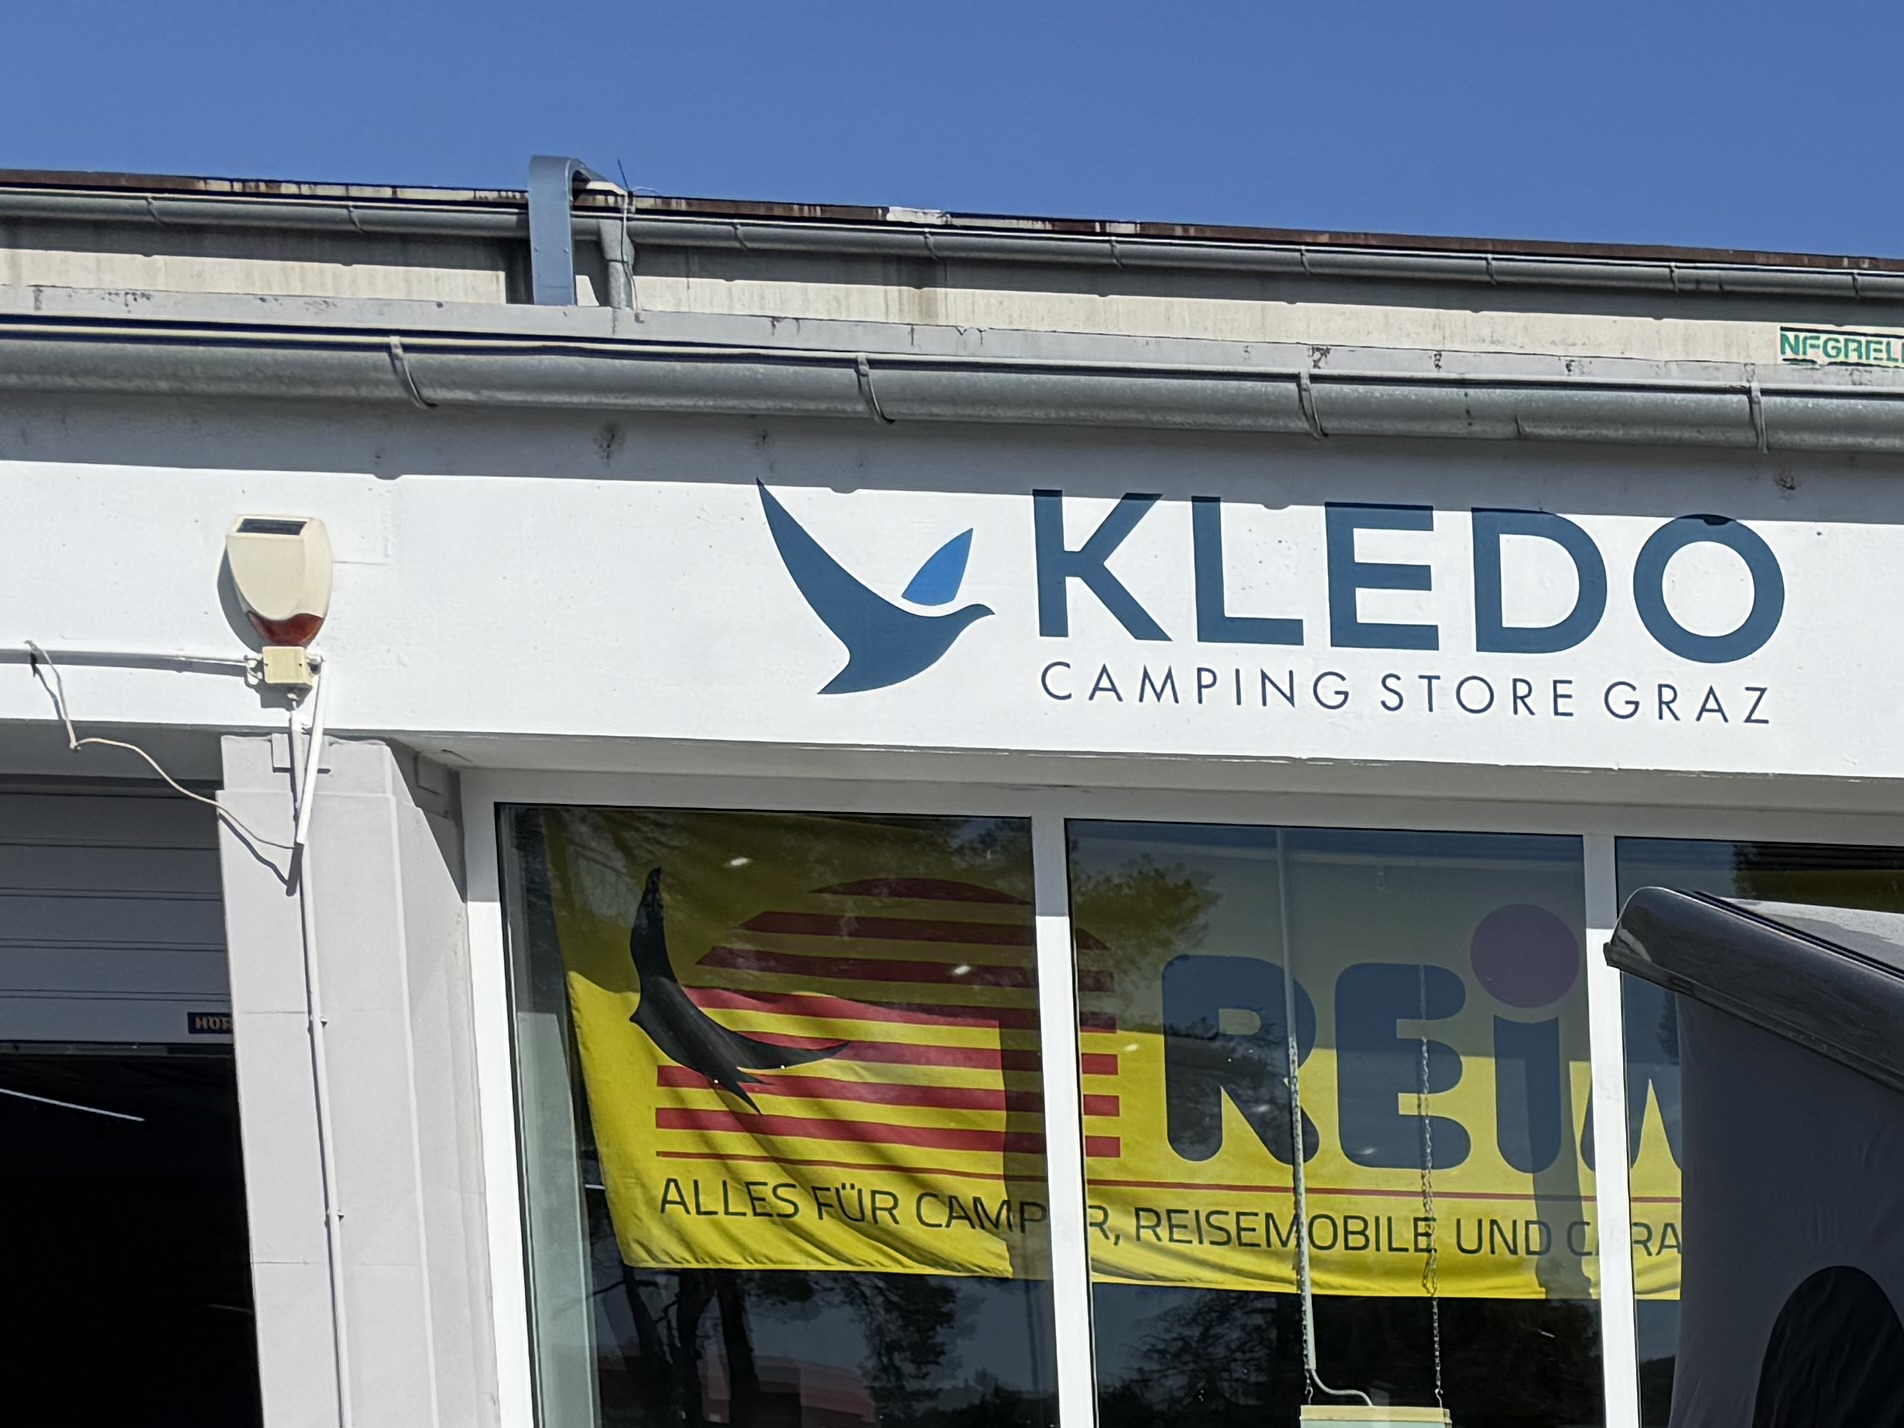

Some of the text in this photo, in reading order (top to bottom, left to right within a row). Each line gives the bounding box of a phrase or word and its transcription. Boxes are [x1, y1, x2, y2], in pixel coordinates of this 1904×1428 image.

[1032, 489, 1786, 665] KLEDO
[1039, 660, 1770, 726] CAMPING STORE GRAZ
[660, 1177, 798, 1220] ALLES
[812, 1182, 898, 1227] FÜR
[915, 1190, 1121, 1247] CAMPR,
[1135, 1206, 1438, 1255] REISEMOBILE
[1456, 1217, 1551, 1257] UND
